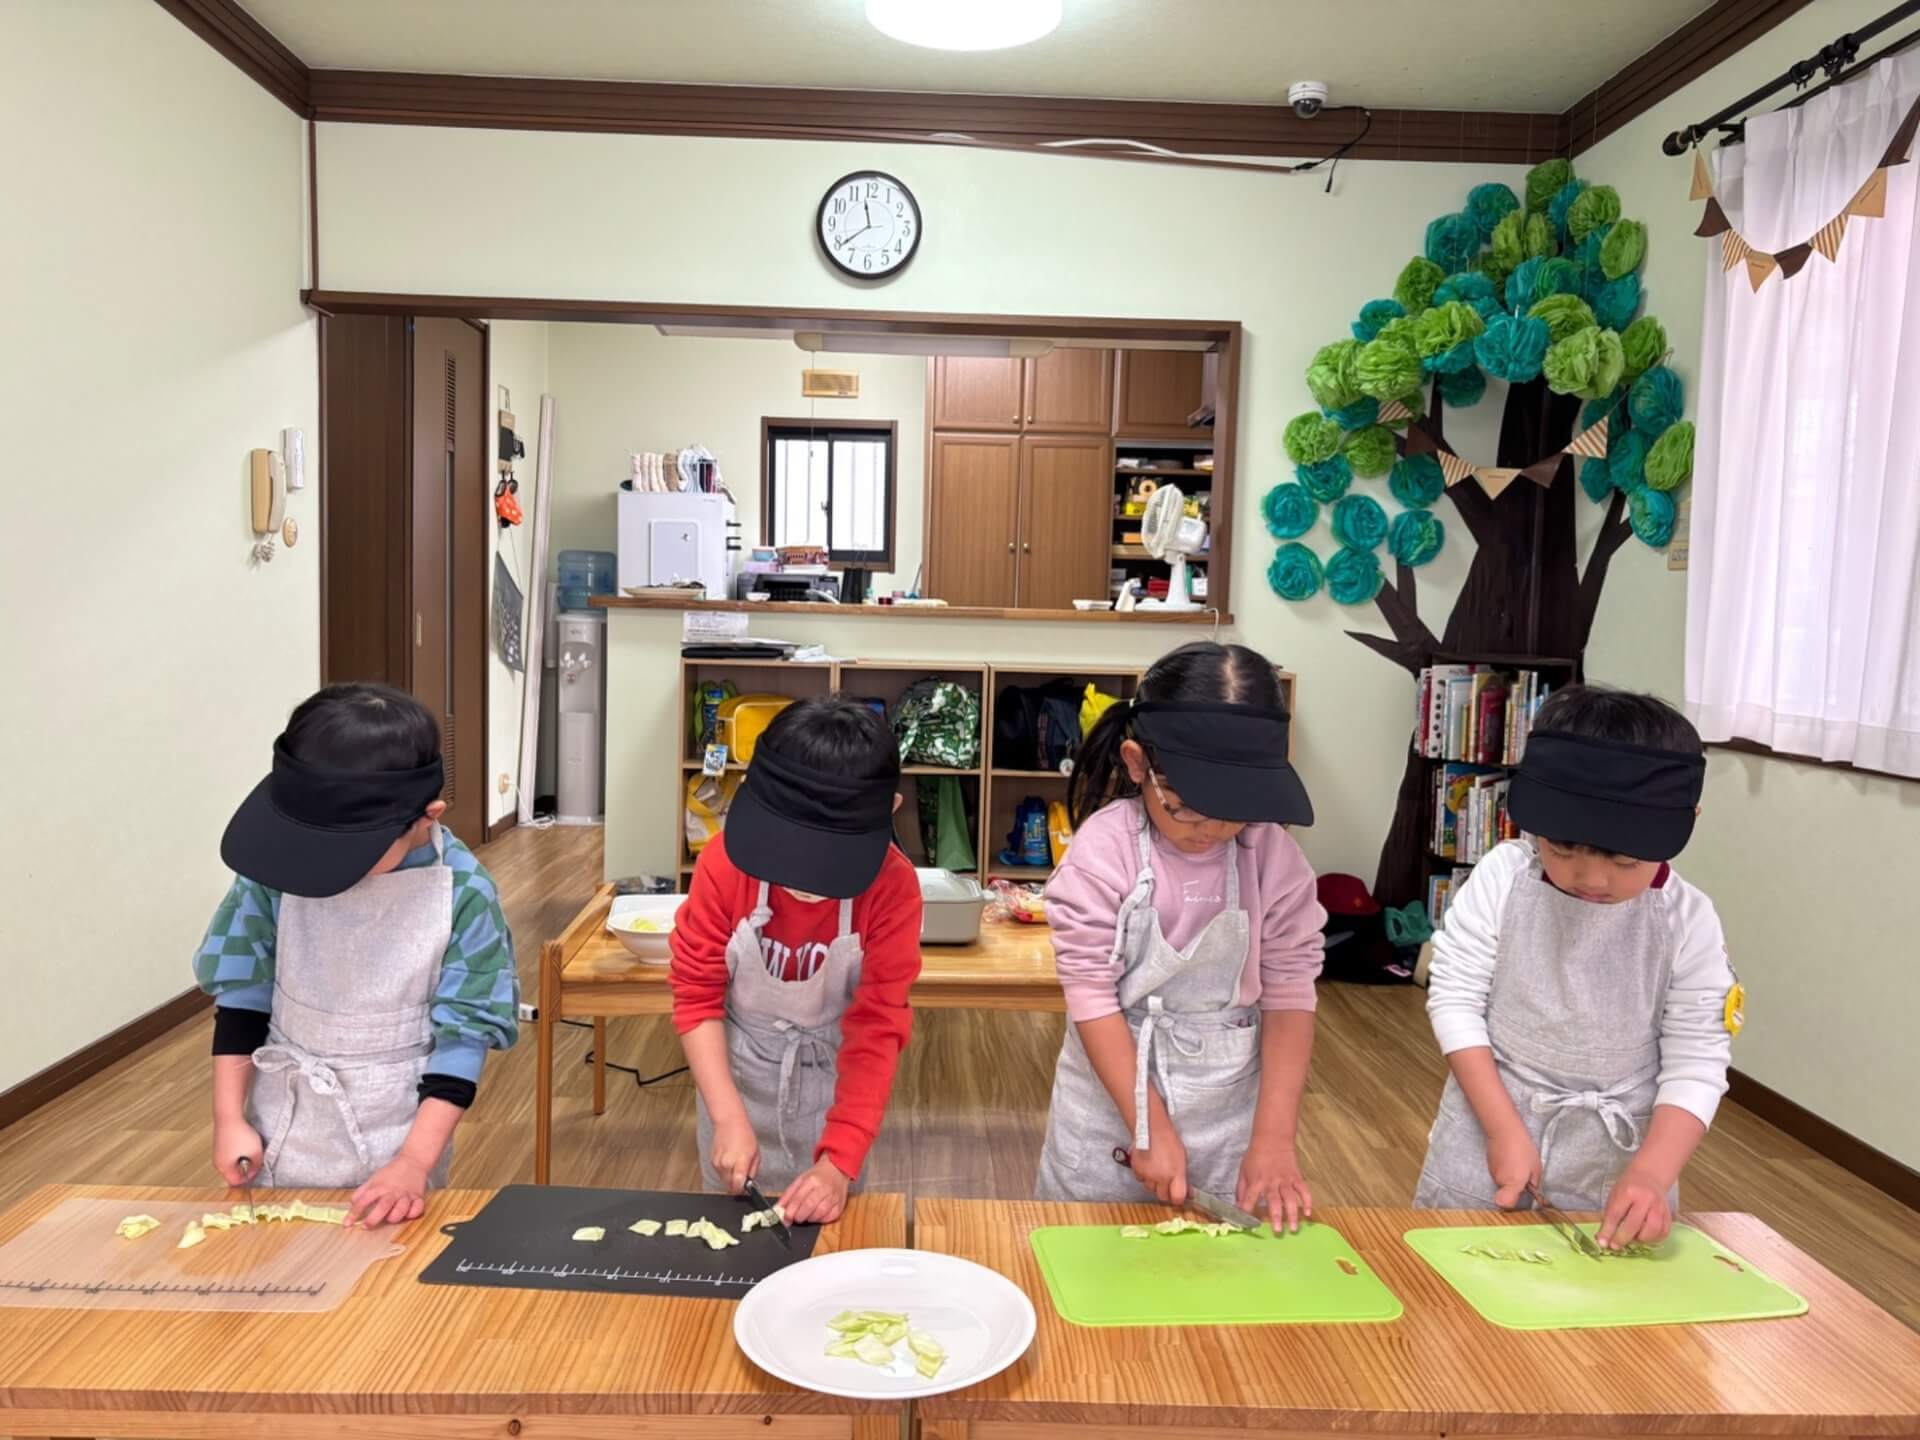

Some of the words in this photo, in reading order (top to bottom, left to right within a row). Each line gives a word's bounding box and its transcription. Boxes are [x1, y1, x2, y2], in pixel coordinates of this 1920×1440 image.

[849, 185, 859, 202] 11
[866, 182, 879, 198] 12
[834, 198, 847, 214] 10
[896, 201, 904, 218] 2
[828, 215, 836, 232] 9
[902, 220, 911, 237] 3
[833, 235, 842, 251] 8
[894, 238, 902, 255] 4
[848, 247, 856, 264] 7
[863, 254, 872, 270] 6
[881, 249, 889, 266] 5
